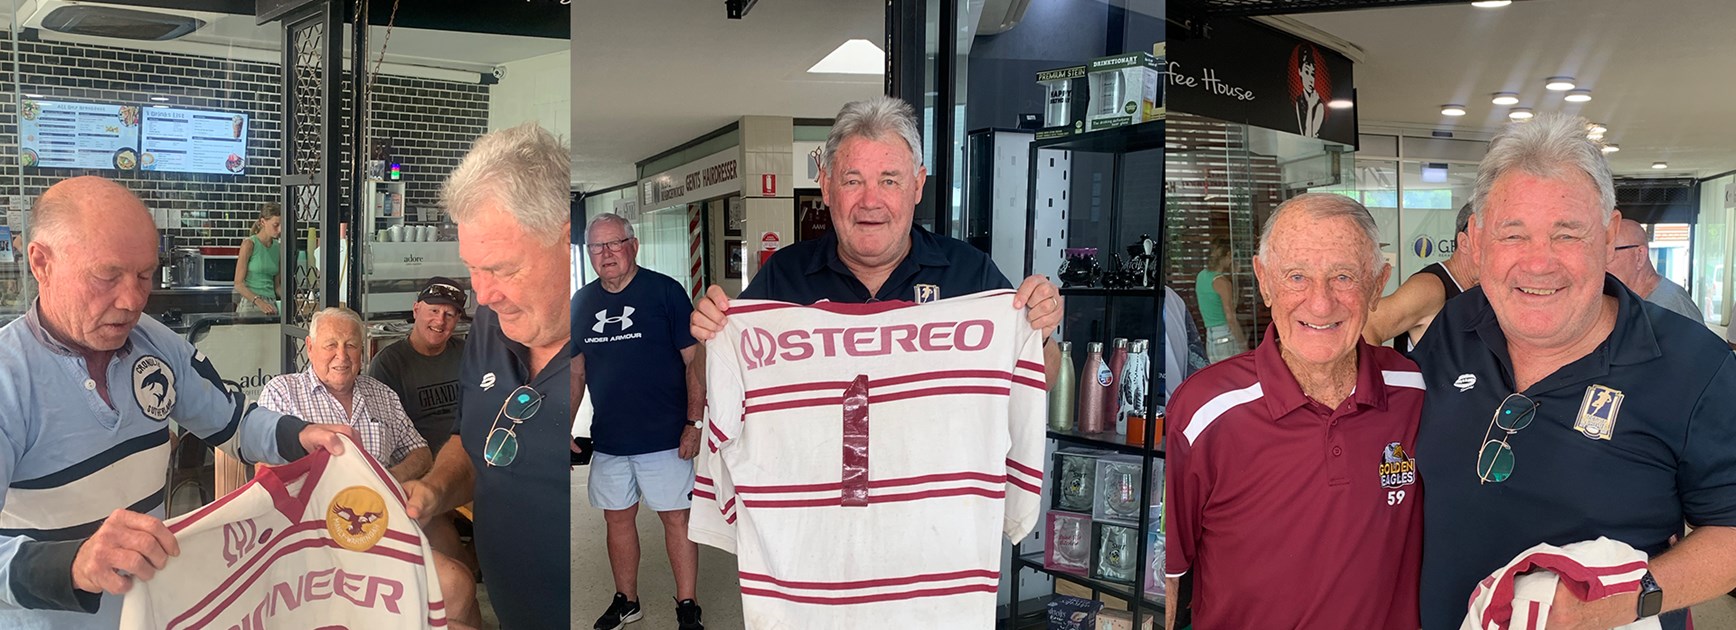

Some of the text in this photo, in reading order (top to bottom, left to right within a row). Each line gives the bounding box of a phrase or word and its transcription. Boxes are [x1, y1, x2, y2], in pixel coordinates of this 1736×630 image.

[1093, 56, 1138, 67] DRINKTIONARY
[1038, 67, 1086, 80] PREMIUM STEIN
[1166, 61, 1198, 87] fee
[1201, 68, 1255, 100] House
[685, 159, 738, 192] GENTS HAIRDRESSER
[403, 253, 424, 263] adore
[610, 332, 642, 342] ARMOUR
[777, 319, 994, 361] STEREO
[841, 374, 869, 507] 1
[1379, 461, 1413, 475] GOLDEN
[1381, 472, 1413, 487] EAGLES
[1387, 490, 1406, 506] 59
[227, 566, 405, 630] IONEER
